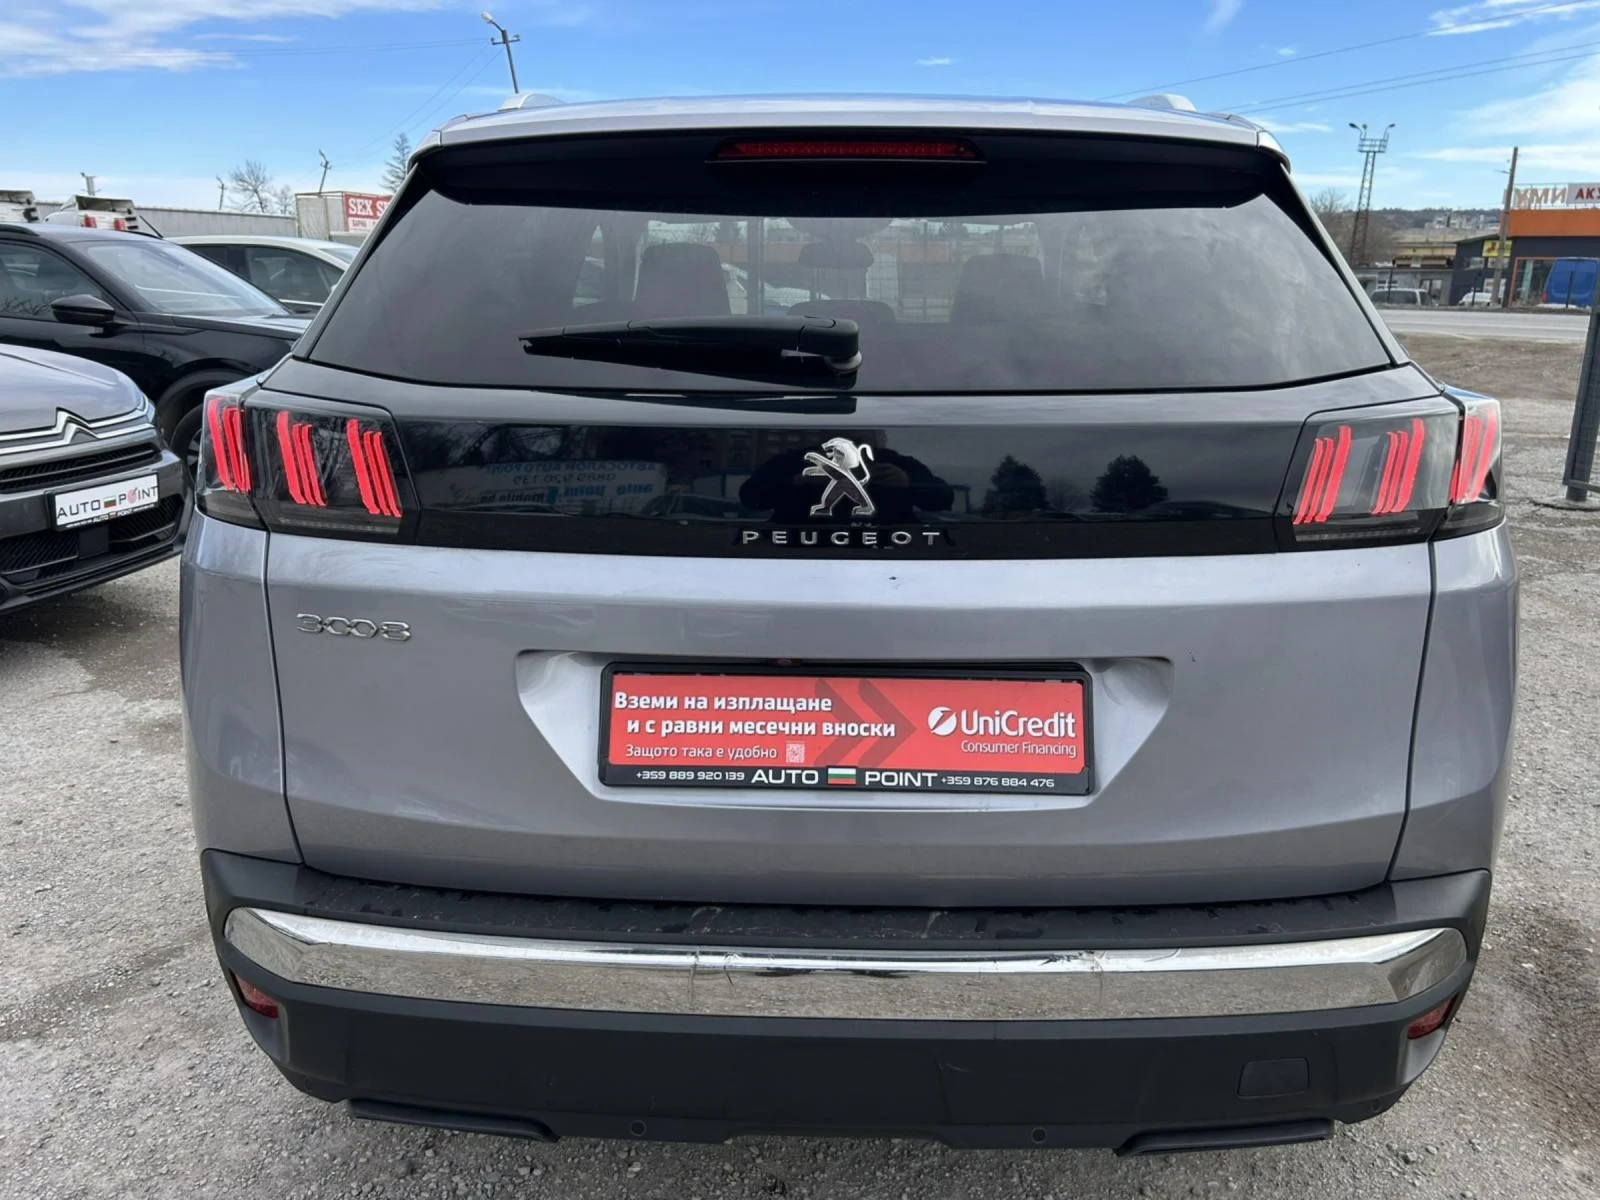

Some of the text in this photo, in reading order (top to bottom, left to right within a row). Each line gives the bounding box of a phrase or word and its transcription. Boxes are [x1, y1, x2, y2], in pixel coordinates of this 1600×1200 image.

[1502, 187, 1567, 204] УМИ
[348, 198, 373, 216] SEX
[57, 499, 101, 519] AUTO
[742, 530, 940, 545] PEUGEOT
[296, 613, 411, 641] 3008
[614, 692, 832, 714] Вземи на изплащане
[627, 719, 896, 737] и с равни месечни вноски
[960, 708, 1076, 738] UniCredit
[625, 743, 777, 760] Защото така е удобно
[961, 739, 1077, 758] Consumer Financing
[636, 769, 1055, 788] +359 889 920 139 AUTO POINT +359 876 884 476
